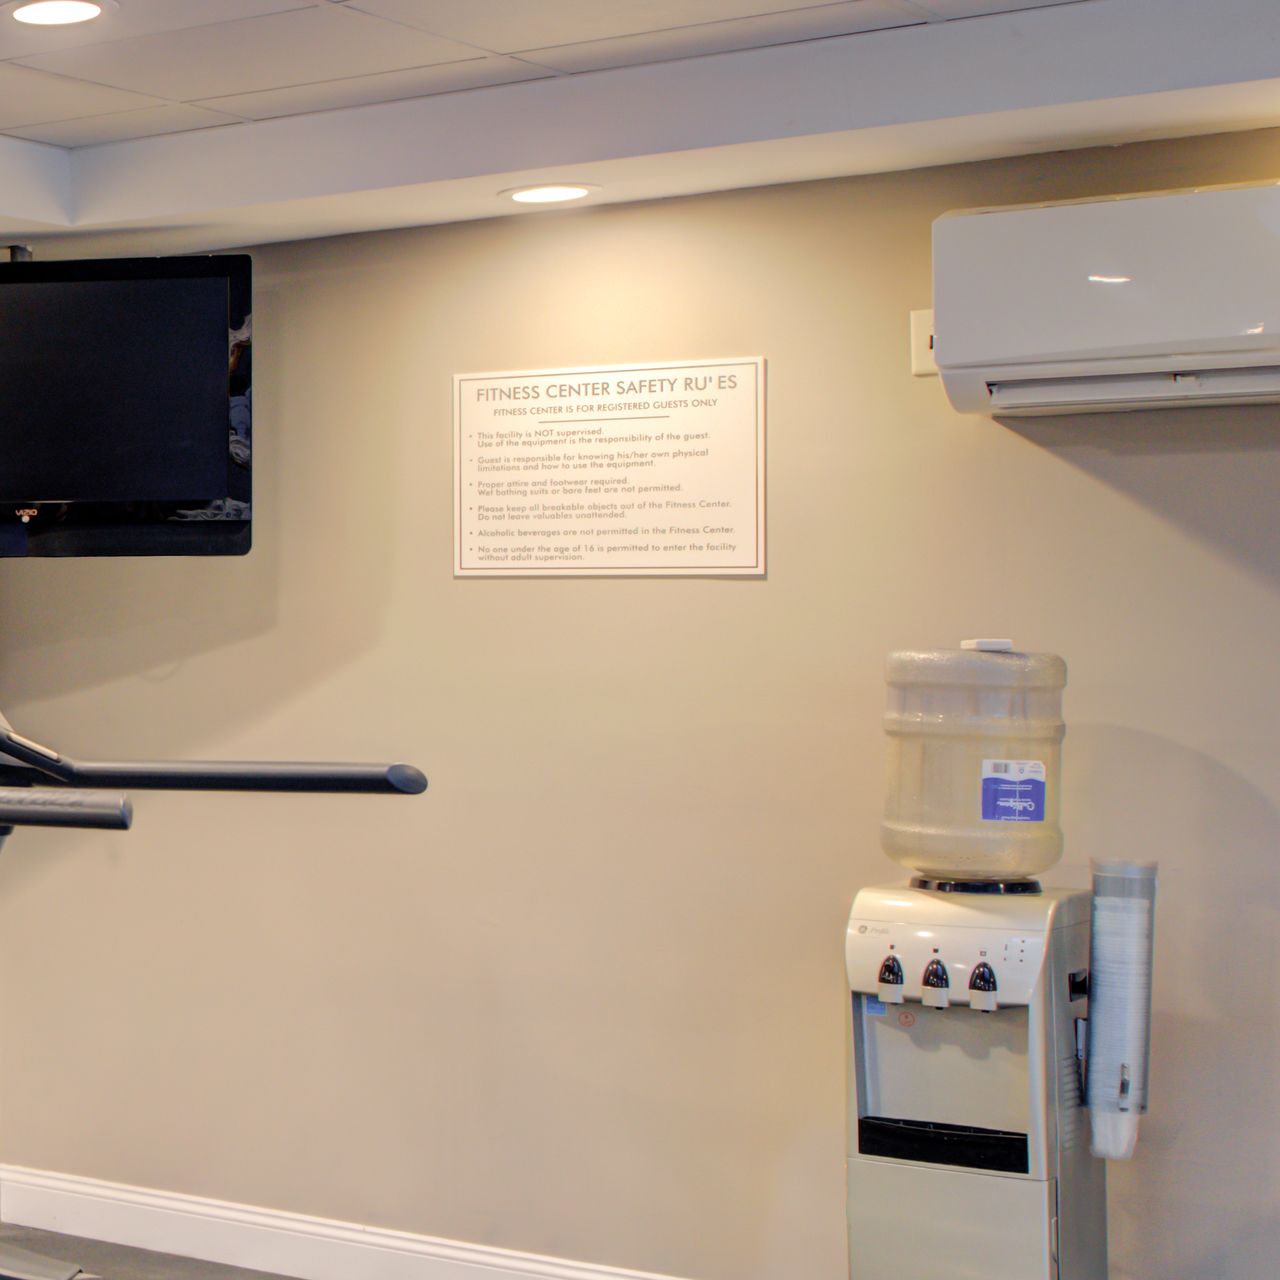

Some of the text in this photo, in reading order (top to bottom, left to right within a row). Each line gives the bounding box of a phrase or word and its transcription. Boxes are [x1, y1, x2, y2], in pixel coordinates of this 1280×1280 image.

[476, 386, 540, 402] FITNESS
[546, 382, 610, 398] CENTER
[616, 378, 678, 395] SAFETY
[493, 398, 718, 416] FITNESS CENTER IS FOR REGISTERED GUESTS ONLY
[477, 440, 493, 448] Use
[521, 438, 567, 447] equipment
[595, 433, 652, 445] responsibility
[654, 433, 664, 441] of
[666, 432, 681, 440] the
[496, 431, 523, 439] facility
[534, 429, 554, 437] NOT
[477, 456, 501, 464] Guest
[504, 455, 510, 463] is
[513, 453, 560, 464] responsible
[563, 453, 575, 461] for
[578, 452, 614, 461] knowing
[617, 451, 648, 459] his/her
[672, 448, 709, 459] physical
[477, 464, 520, 472] limitations
[522, 463, 539, 471] and
[541, 462, 559, 470] how
[506, 504, 527, 513] keep
[542, 502, 585, 511] breakable
[587, 502, 618, 511] objects
[620, 502, 635, 510] out
[637, 501, 646, 509] of
[648, 501, 663, 509] the
[665, 500, 696, 508] Fitness
[508, 512, 530, 520] leave
[532, 512, 572, 520] valuables
[517, 528, 560, 538] beverages
[596, 527, 639, 536] permitted
[669, 526, 700, 534] Fitness
[478, 545, 490, 553] No
[538, 544, 551, 552] the
[553, 545, 570, 554] age
[572, 544, 581, 552] of
[583, 544, 594, 552] 16
[606, 544, 649, 553] permitted
[651, 544, 660, 552] to
[689, 543, 703, 551] the
[705, 542, 736, 552] facility
[510, 553, 532, 561] adult
